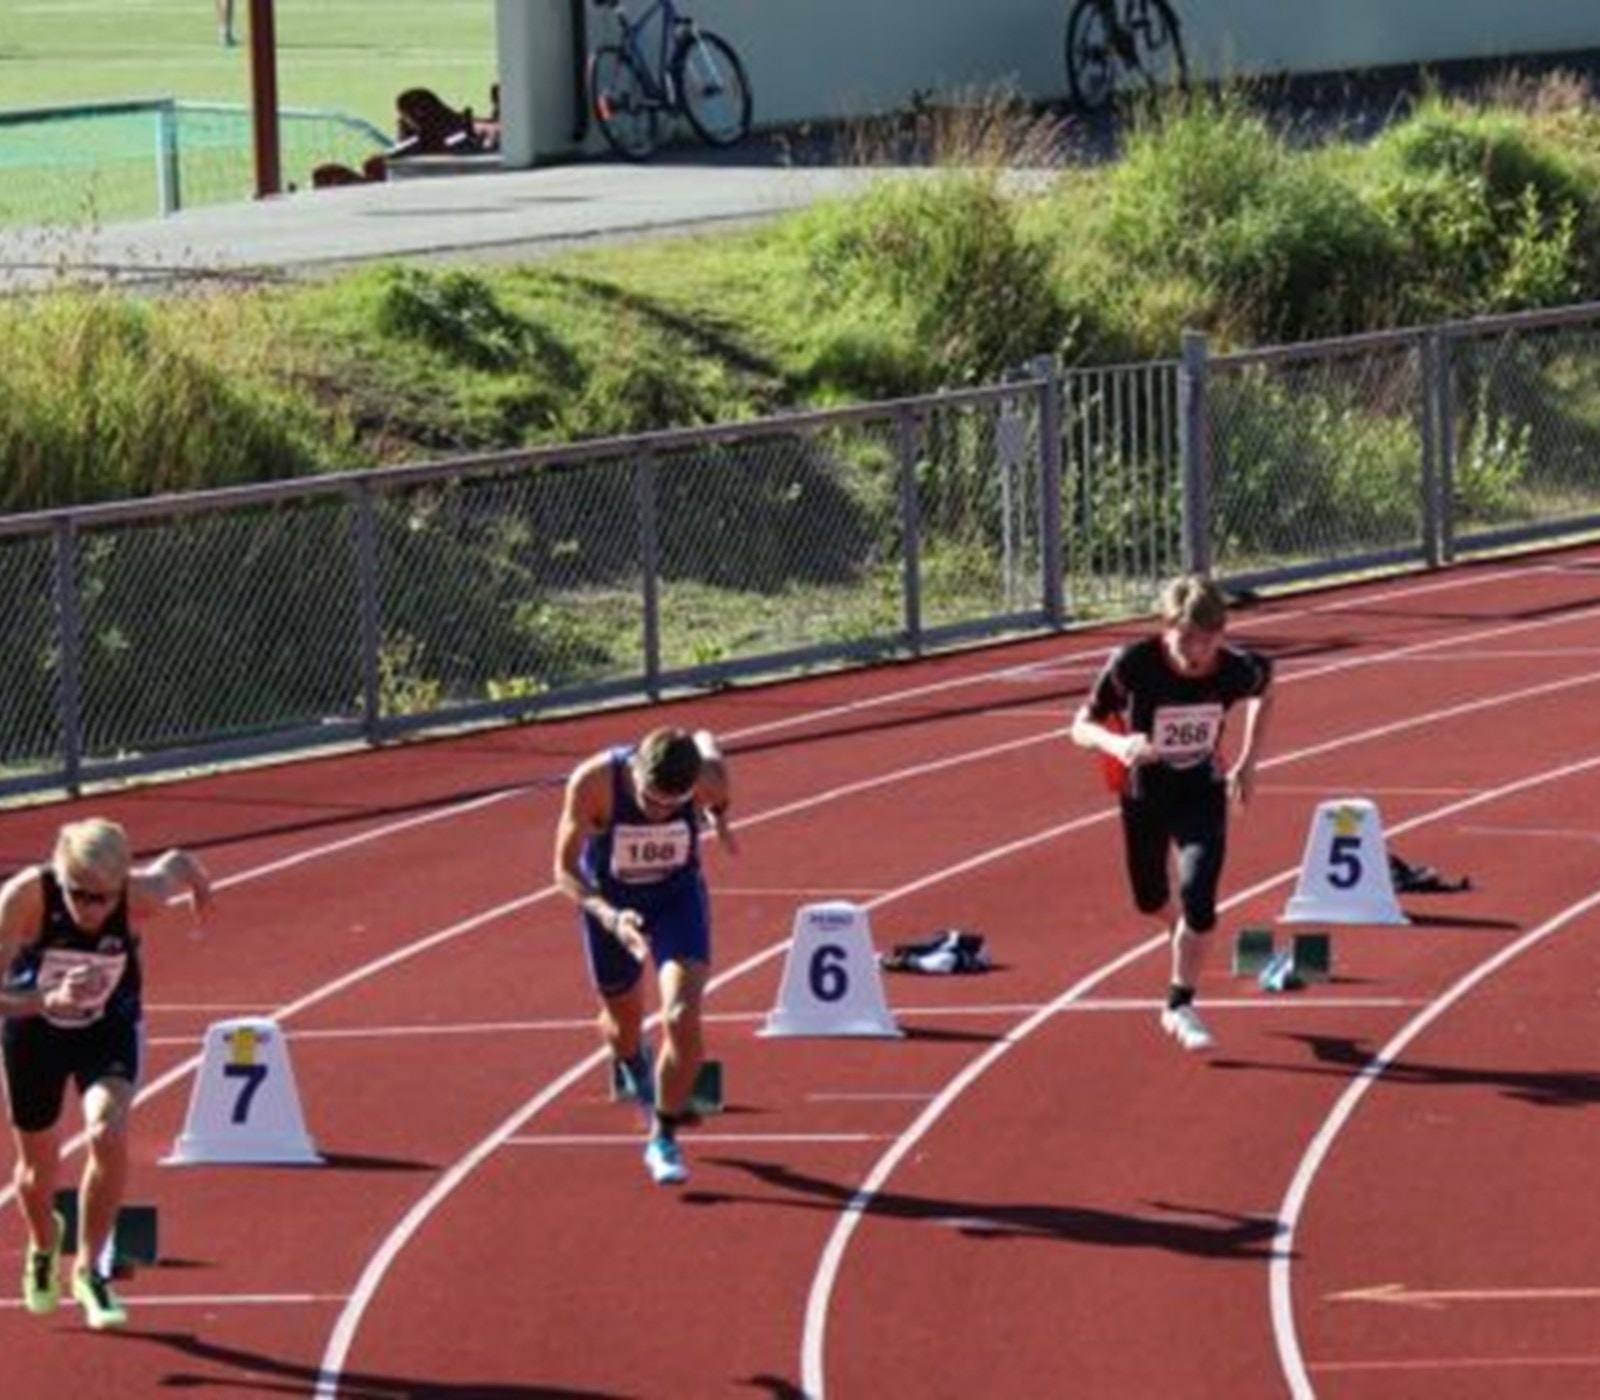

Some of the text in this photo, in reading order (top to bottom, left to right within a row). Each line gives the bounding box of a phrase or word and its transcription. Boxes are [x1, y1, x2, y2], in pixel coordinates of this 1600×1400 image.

[1327, 837, 1362, 889] 5
[809, 944, 848, 1002] 6
[223, 1064, 268, 1124] 7
